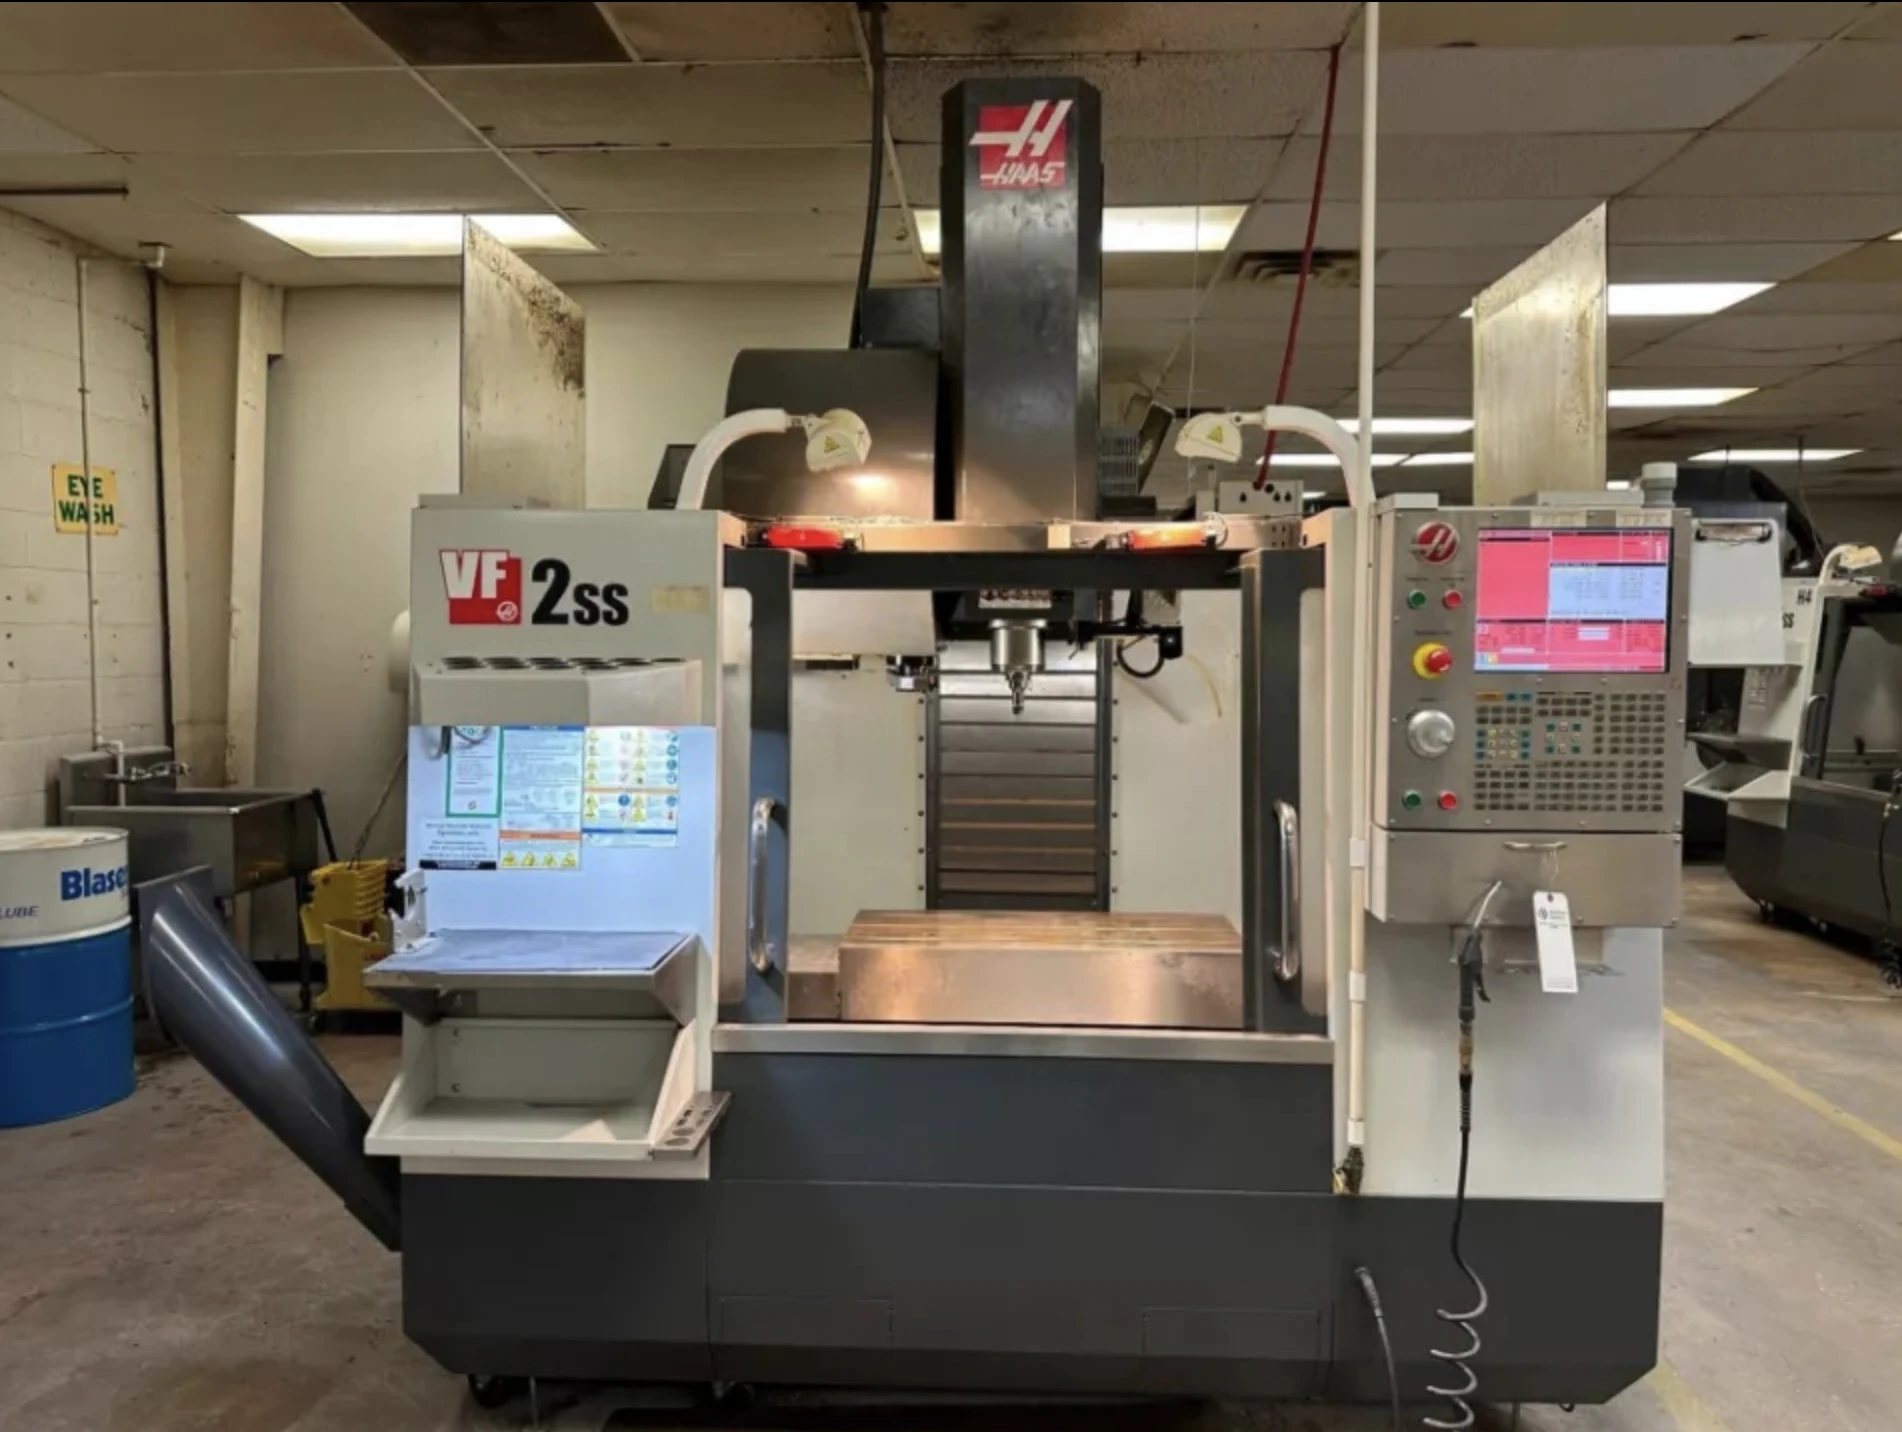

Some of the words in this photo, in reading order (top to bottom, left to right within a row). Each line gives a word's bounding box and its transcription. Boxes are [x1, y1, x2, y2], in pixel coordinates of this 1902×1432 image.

[980, 161, 1065, 185] HAAS
[67, 474, 104, 498] EYE
[58, 499, 115, 525] WASH
[440, 550, 510, 600] VF
[1781, 611, 1795, 629] SS
[61, 865, 128, 901] Blase
